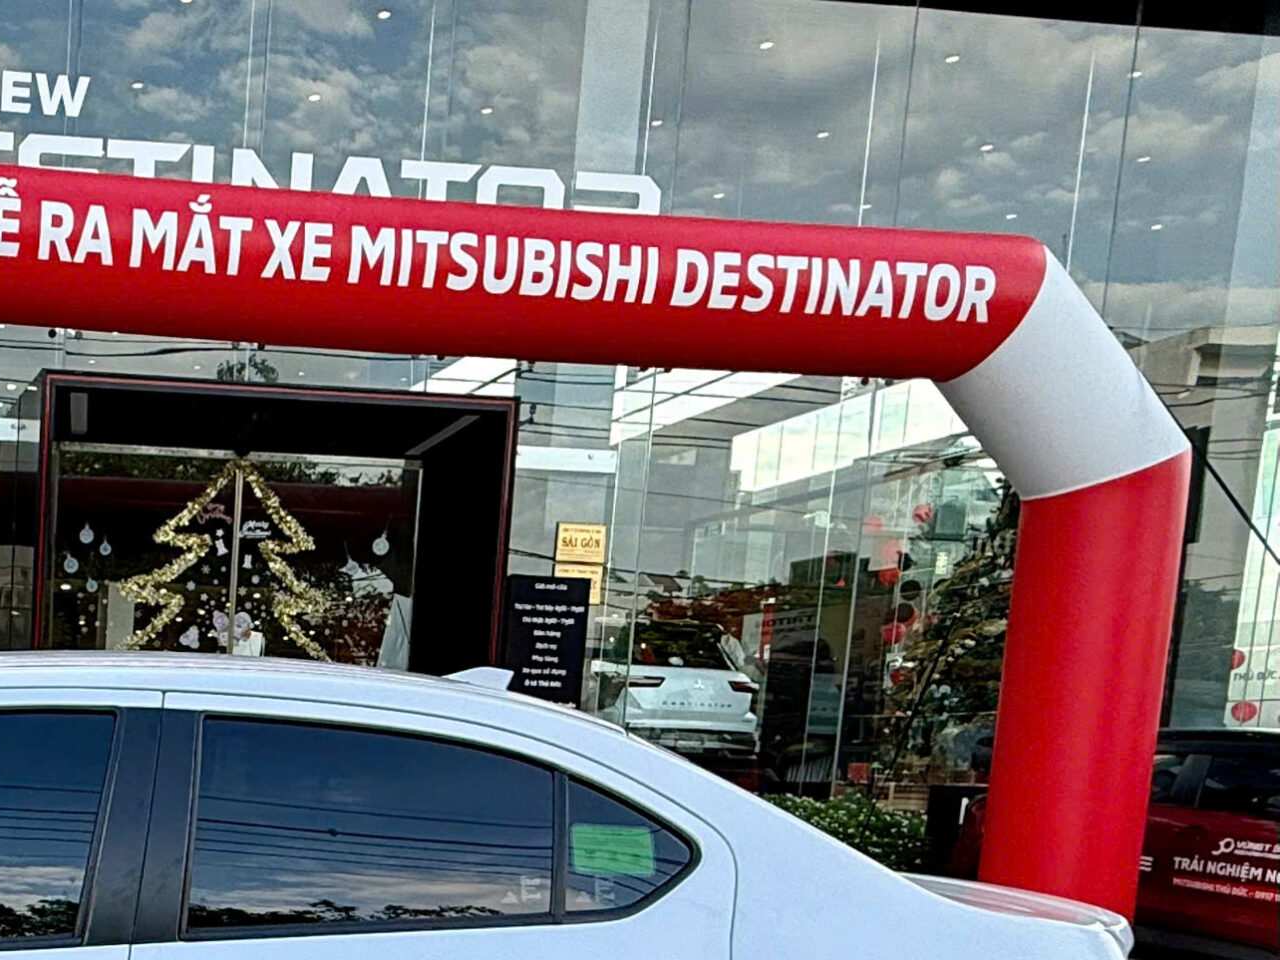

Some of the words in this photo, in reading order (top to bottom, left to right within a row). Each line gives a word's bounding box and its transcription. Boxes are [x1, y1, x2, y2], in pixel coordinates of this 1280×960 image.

[37, 200, 114, 266] RA
[129, 194, 254, 276] MẮT
[260, 219, 334, 282] XE
[347, 225, 660, 305] MITSUBISHI
[670, 248, 997, 323] DESTINATOR
[1173, 855, 1205, 873] TRẢI
[1206, 861, 1264, 882] NGHIỆM
